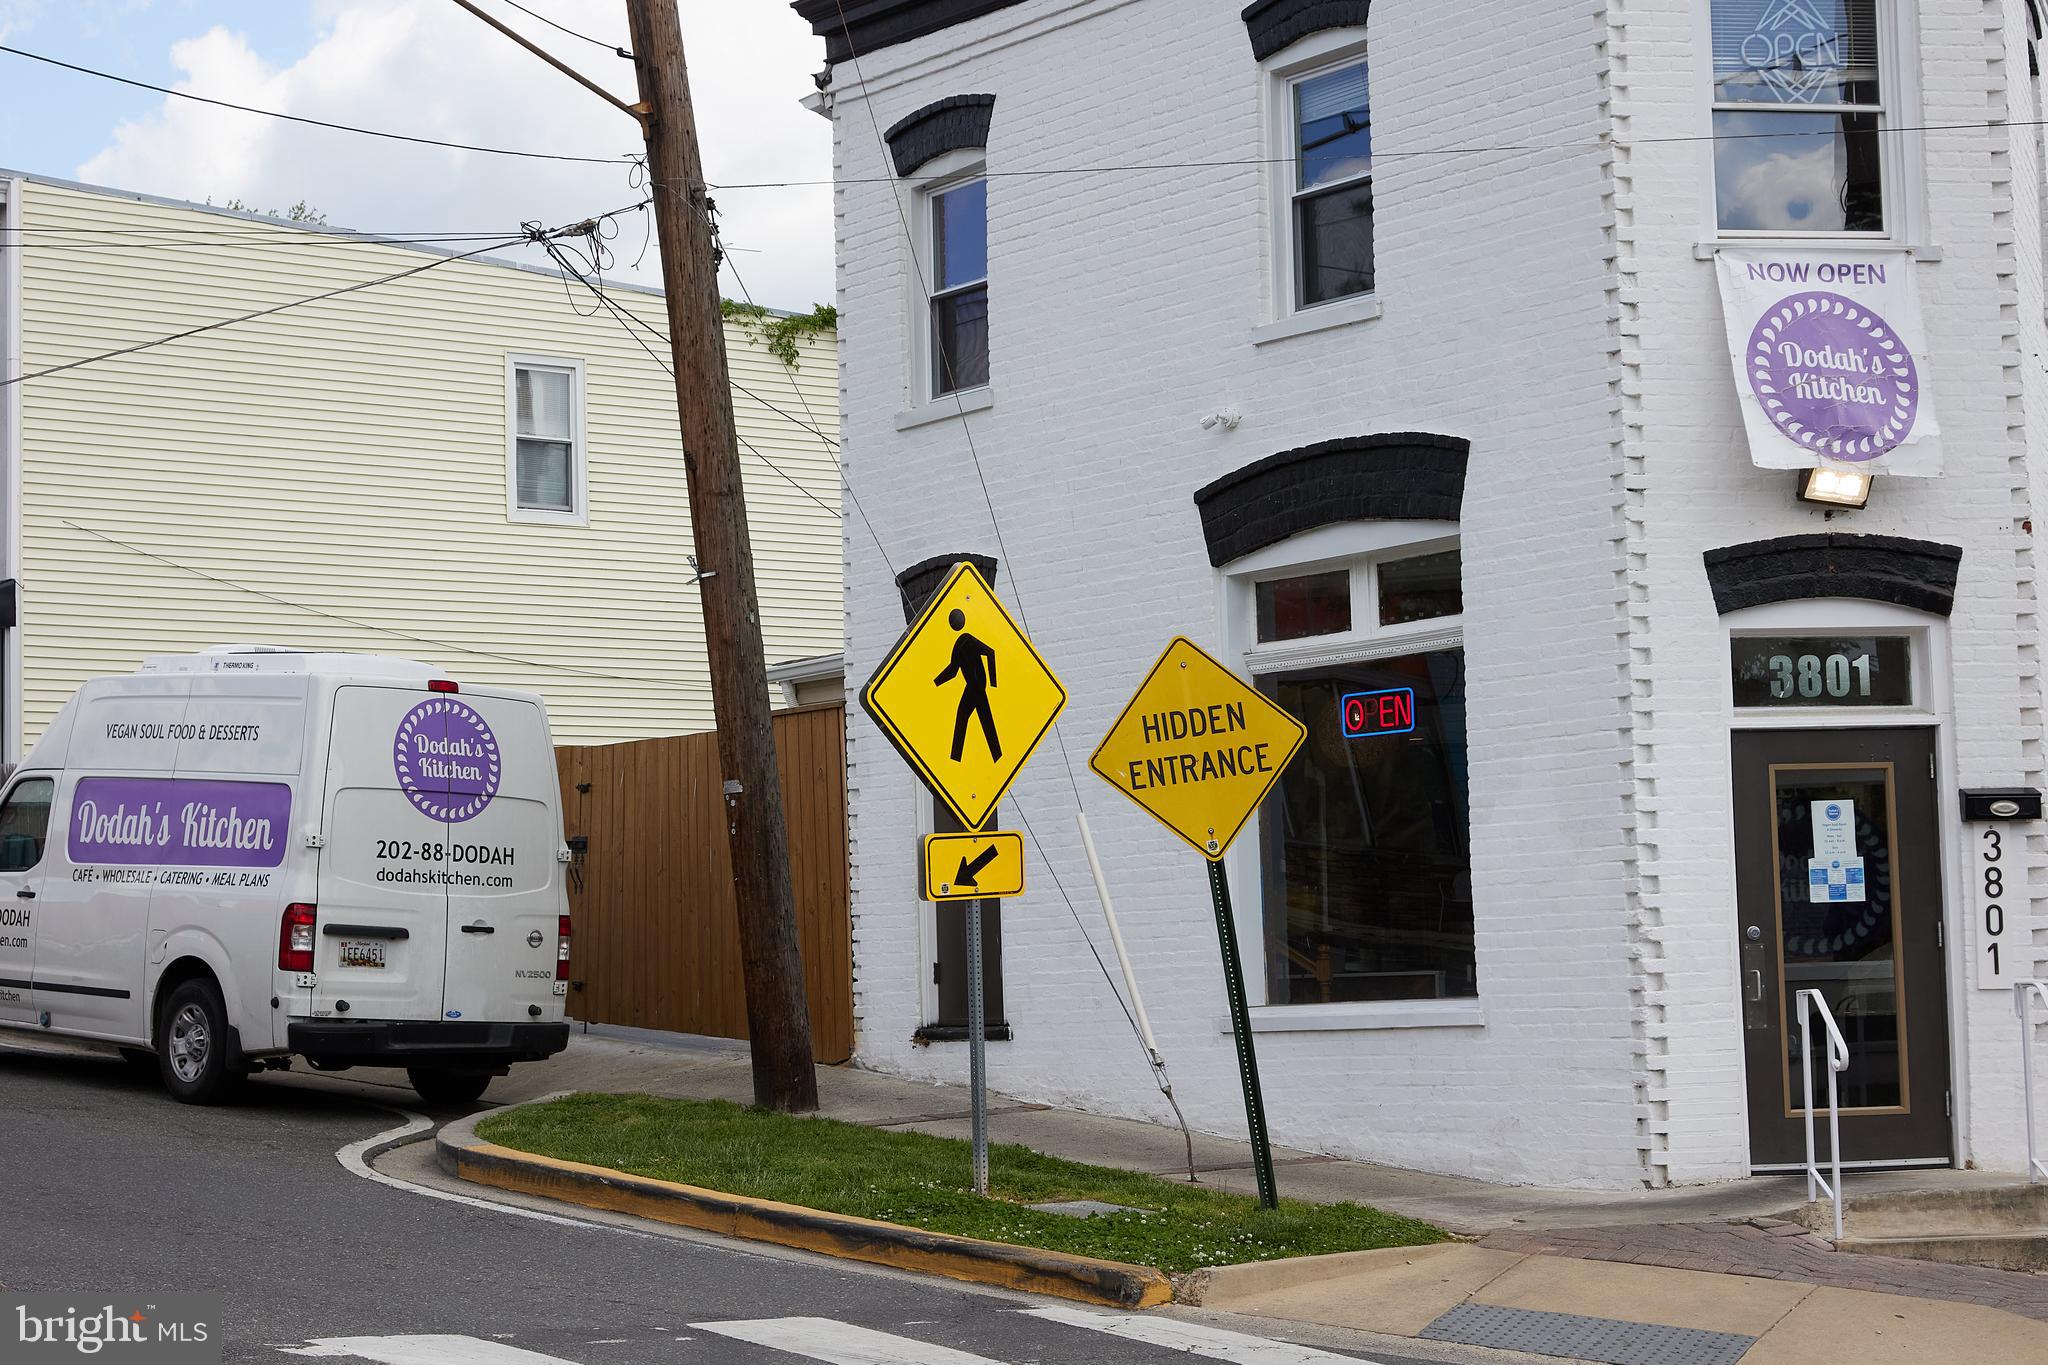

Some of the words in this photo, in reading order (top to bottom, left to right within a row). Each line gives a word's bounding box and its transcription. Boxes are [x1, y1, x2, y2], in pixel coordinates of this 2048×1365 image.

[1741, 32, 1840, 67] OPEN
[1746, 262, 1810, 283] NOW
[1816, 263, 1887, 285] OPEN
[1778, 341, 1887, 375] Dodah's
[1788, 372, 1887, 405] Kitchen
[1769, 654, 1872, 698] 3801
[1141, 701, 1246, 744] HIDDEN
[1345, 694, 1412, 731] OPEN
[106, 723, 138, 739] VEGAN
[139, 723, 164, 740] SOUL
[167, 724, 196, 740] FOOD
[198, 724, 206, 740] &
[208, 725, 260, 741] DESSERTS
[413, 733, 485, 758] Dodah's
[418, 757, 483, 781] Kitchen
[1128, 743, 1273, 790] ENTRANCE
[78, 800, 171, 846] Dodah's
[180, 801, 274, 850] Kitchen
[376, 839, 515, 866] 202-88-DODAH
[72, 866, 94, 883] CAFÉ
[102, 869, 152, 884] WHOLESALE
[160, 871, 204, 886] CATERING
[211, 872, 236, 886] MEAL
[238, 873, 271, 888] PLANS
[376, 867, 513, 888] dodahskitchen.com
[1983, 829, 2004, 976] 3801
[514, 970, 551, 979] NV2500
